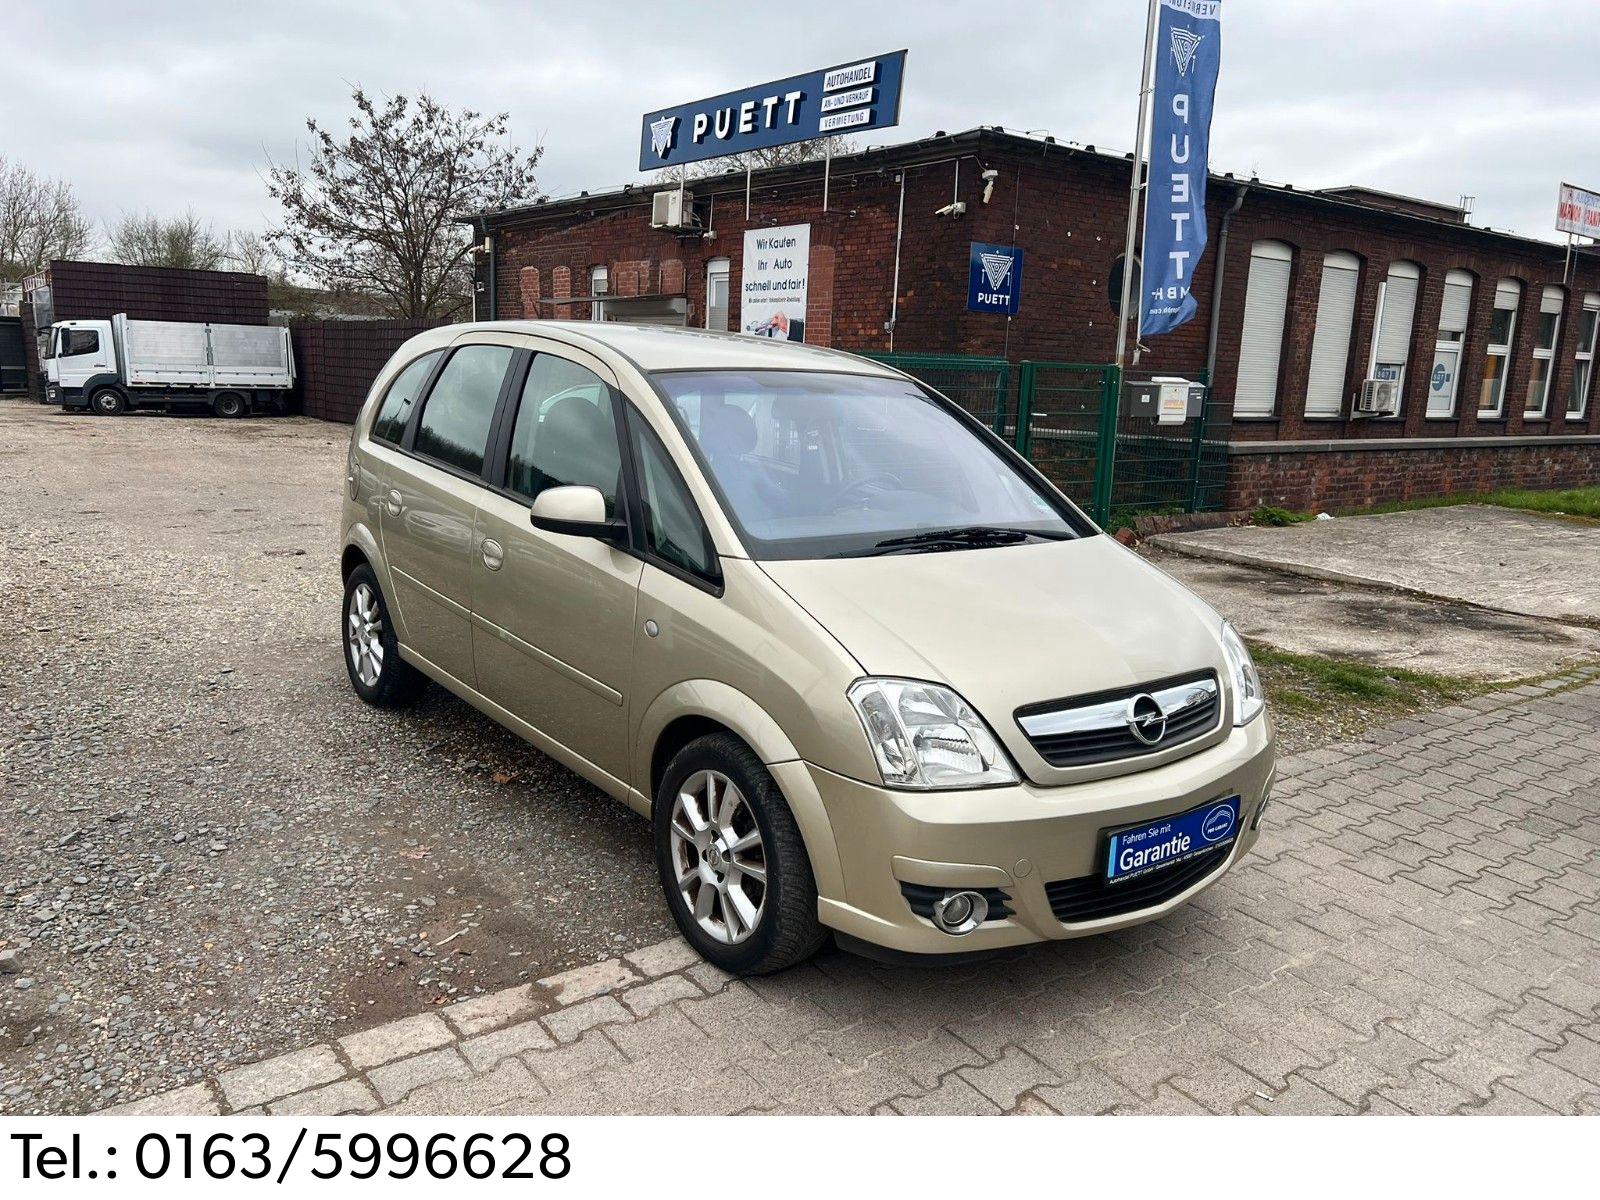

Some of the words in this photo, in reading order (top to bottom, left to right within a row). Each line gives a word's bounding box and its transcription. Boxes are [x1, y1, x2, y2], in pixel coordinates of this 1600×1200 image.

[826, 70, 872, 88] AUTOHANDEL
[823, 97, 834, 108] AN-
[834, 94, 844, 107] UND
[845, 90, 870, 105] VERKAUF
[692, 90, 802, 143] PUETT
[824, 111, 865, 128] VERMIETUNG
[757, 238, 768, 250] Wir
[769, 237, 796, 250] Kaufen
[758, 260, 768, 271] Ihr
[773, 258, 793, 270] Auto
[745, 280, 771, 292] schnell
[772, 279, 787, 290] und
[977, 292, 1010, 305] PUETT
[1122, 831, 1146, 846] Fahren
[1148, 827, 1159, 838] Sie
[1160, 823, 1171, 835] mit
[1119, 831, 1191, 871] Garantie
